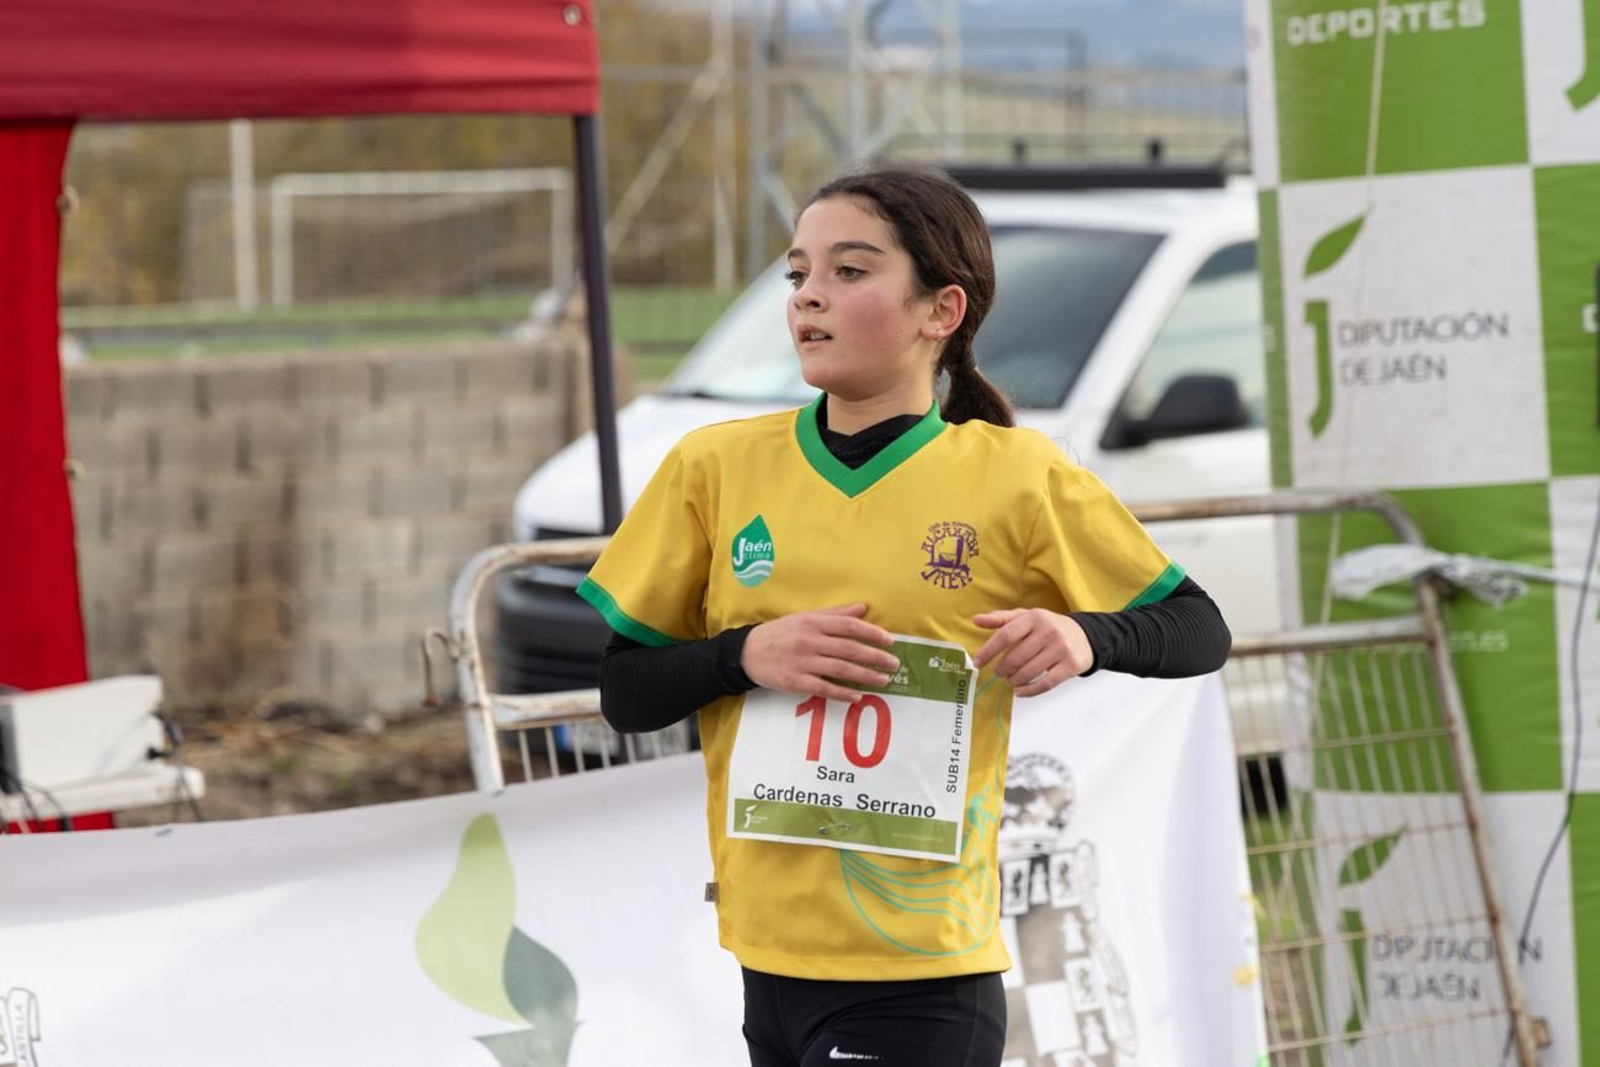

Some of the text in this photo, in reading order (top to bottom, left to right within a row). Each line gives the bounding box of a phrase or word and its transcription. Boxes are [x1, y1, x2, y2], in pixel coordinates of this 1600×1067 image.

[1287, 0, 1486, 46] DEPORTES
[1338, 311, 1509, 348] DIPUTACIÓN
[1339, 353, 1447, 387] DE JAÉN
[733, 538, 772, 566] Jaén
[744, 550, 770, 561] clima
[951, 679, 967, 745] Femenino
[795, 693, 892, 769] 10
[816, 765, 856, 784] Sara
[945, 748, 961, 794] SUB14
[753, 783, 936, 818] Cardenas Serrano
